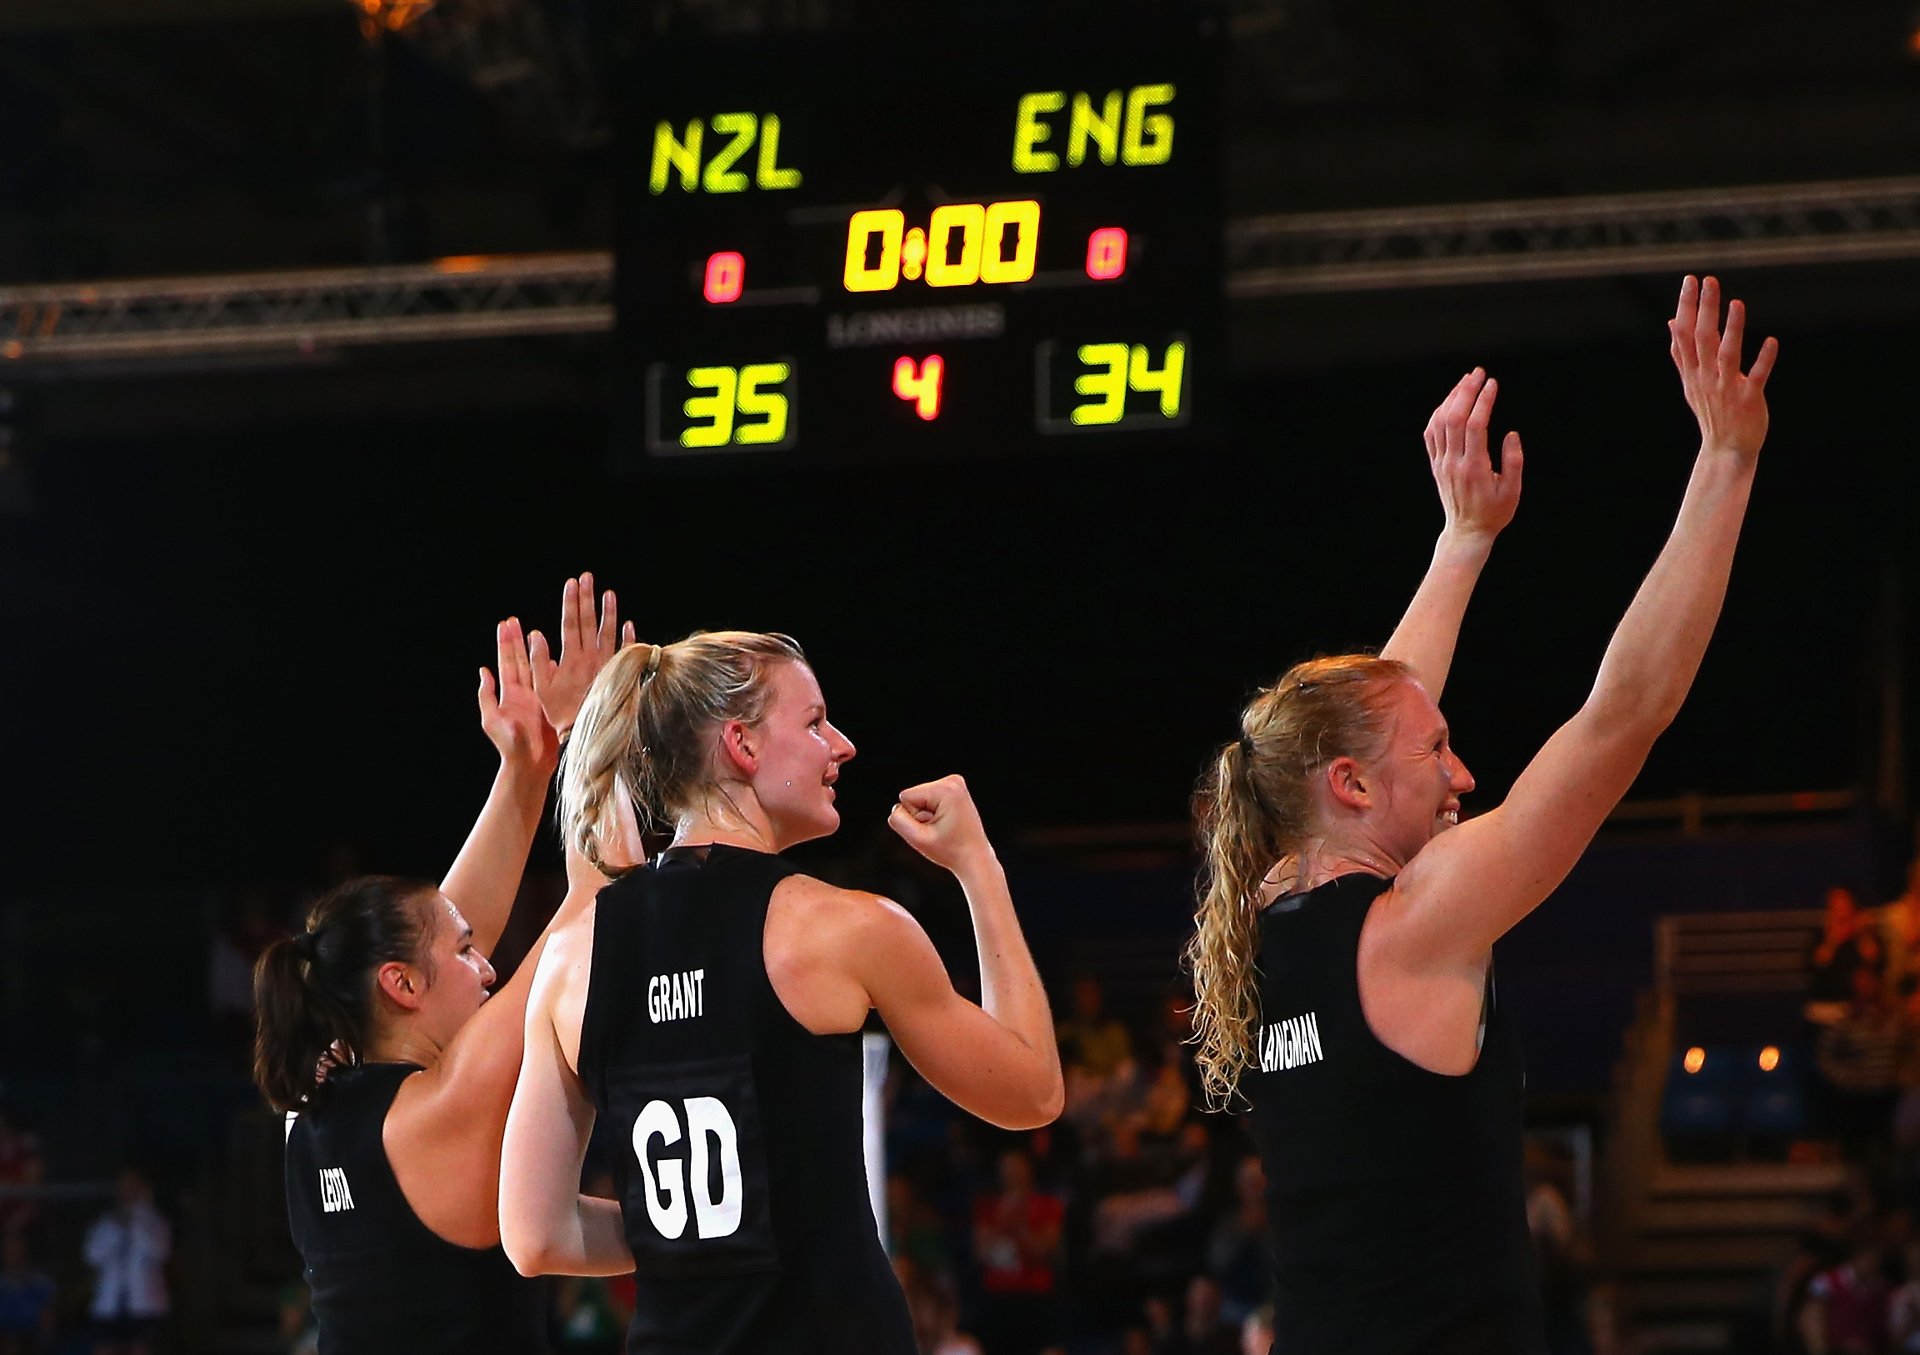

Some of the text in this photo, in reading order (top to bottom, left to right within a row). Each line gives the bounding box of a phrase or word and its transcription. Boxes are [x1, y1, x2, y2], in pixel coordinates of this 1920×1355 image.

[650, 112, 801, 194] NZL
[1012, 84, 1175, 173] ENG
[704, 252, 745, 303] 0
[843, 200, 1040, 292] 0:00
[1086, 227, 1128, 280] 0
[680, 363, 790, 448] 35
[892, 354, 944, 421] 4
[1071, 341, 1185, 426] 34
[648, 969, 705, 1023] GRANT
[1259, 1012, 1323, 1073] LANGMAN
[319, 1167, 355, 1213] LEOTA
[632, 1096, 743, 1240] GD
